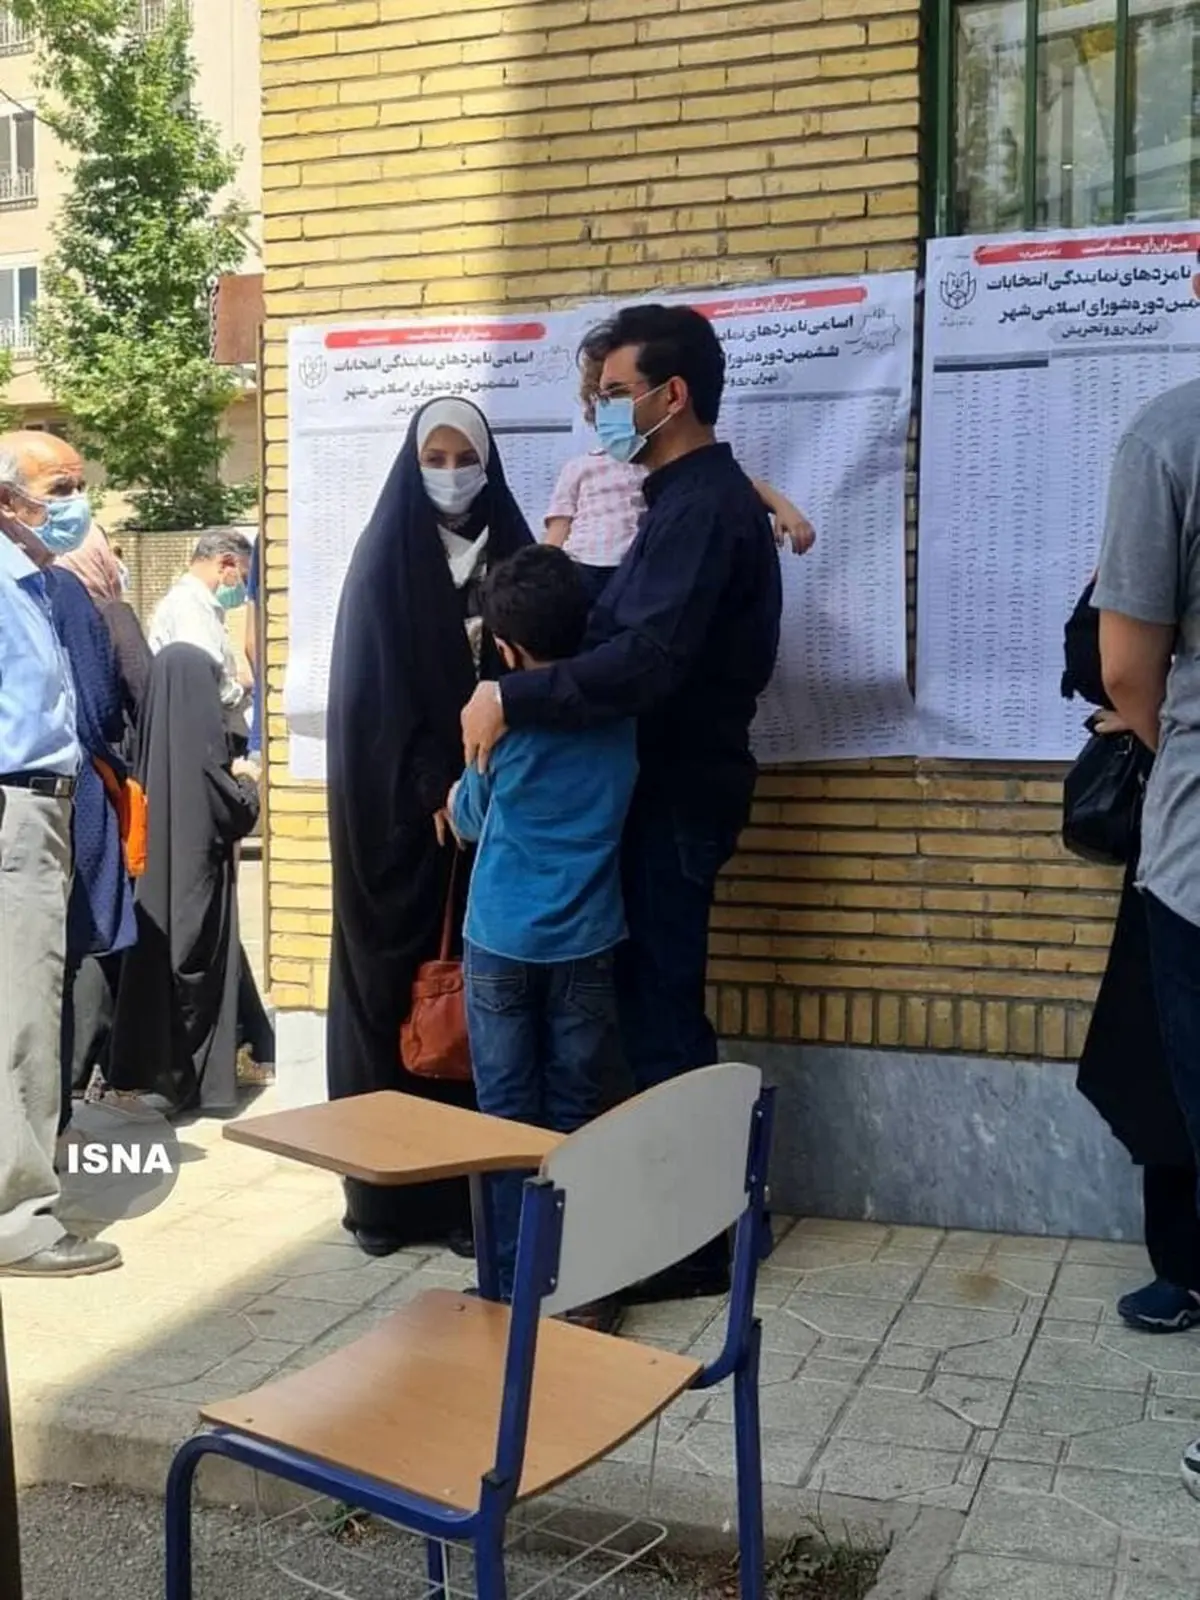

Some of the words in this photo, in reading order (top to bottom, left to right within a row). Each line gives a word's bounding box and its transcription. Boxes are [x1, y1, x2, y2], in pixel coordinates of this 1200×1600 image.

[987, 271, 1048, 291] انتخابات
[1049, 268, 1118, 291] نمایندگی
[998, 303, 1031, 324] شهر
[1032, 300, 1086, 321] اسلامی
[1087, 297, 1132, 317] شورای
[807, 315, 853, 335] اسامی
[491, 351, 533, 368] اسامی
[728, 354, 754, 369] شورا
[784, 346, 839, 363] ششمین
